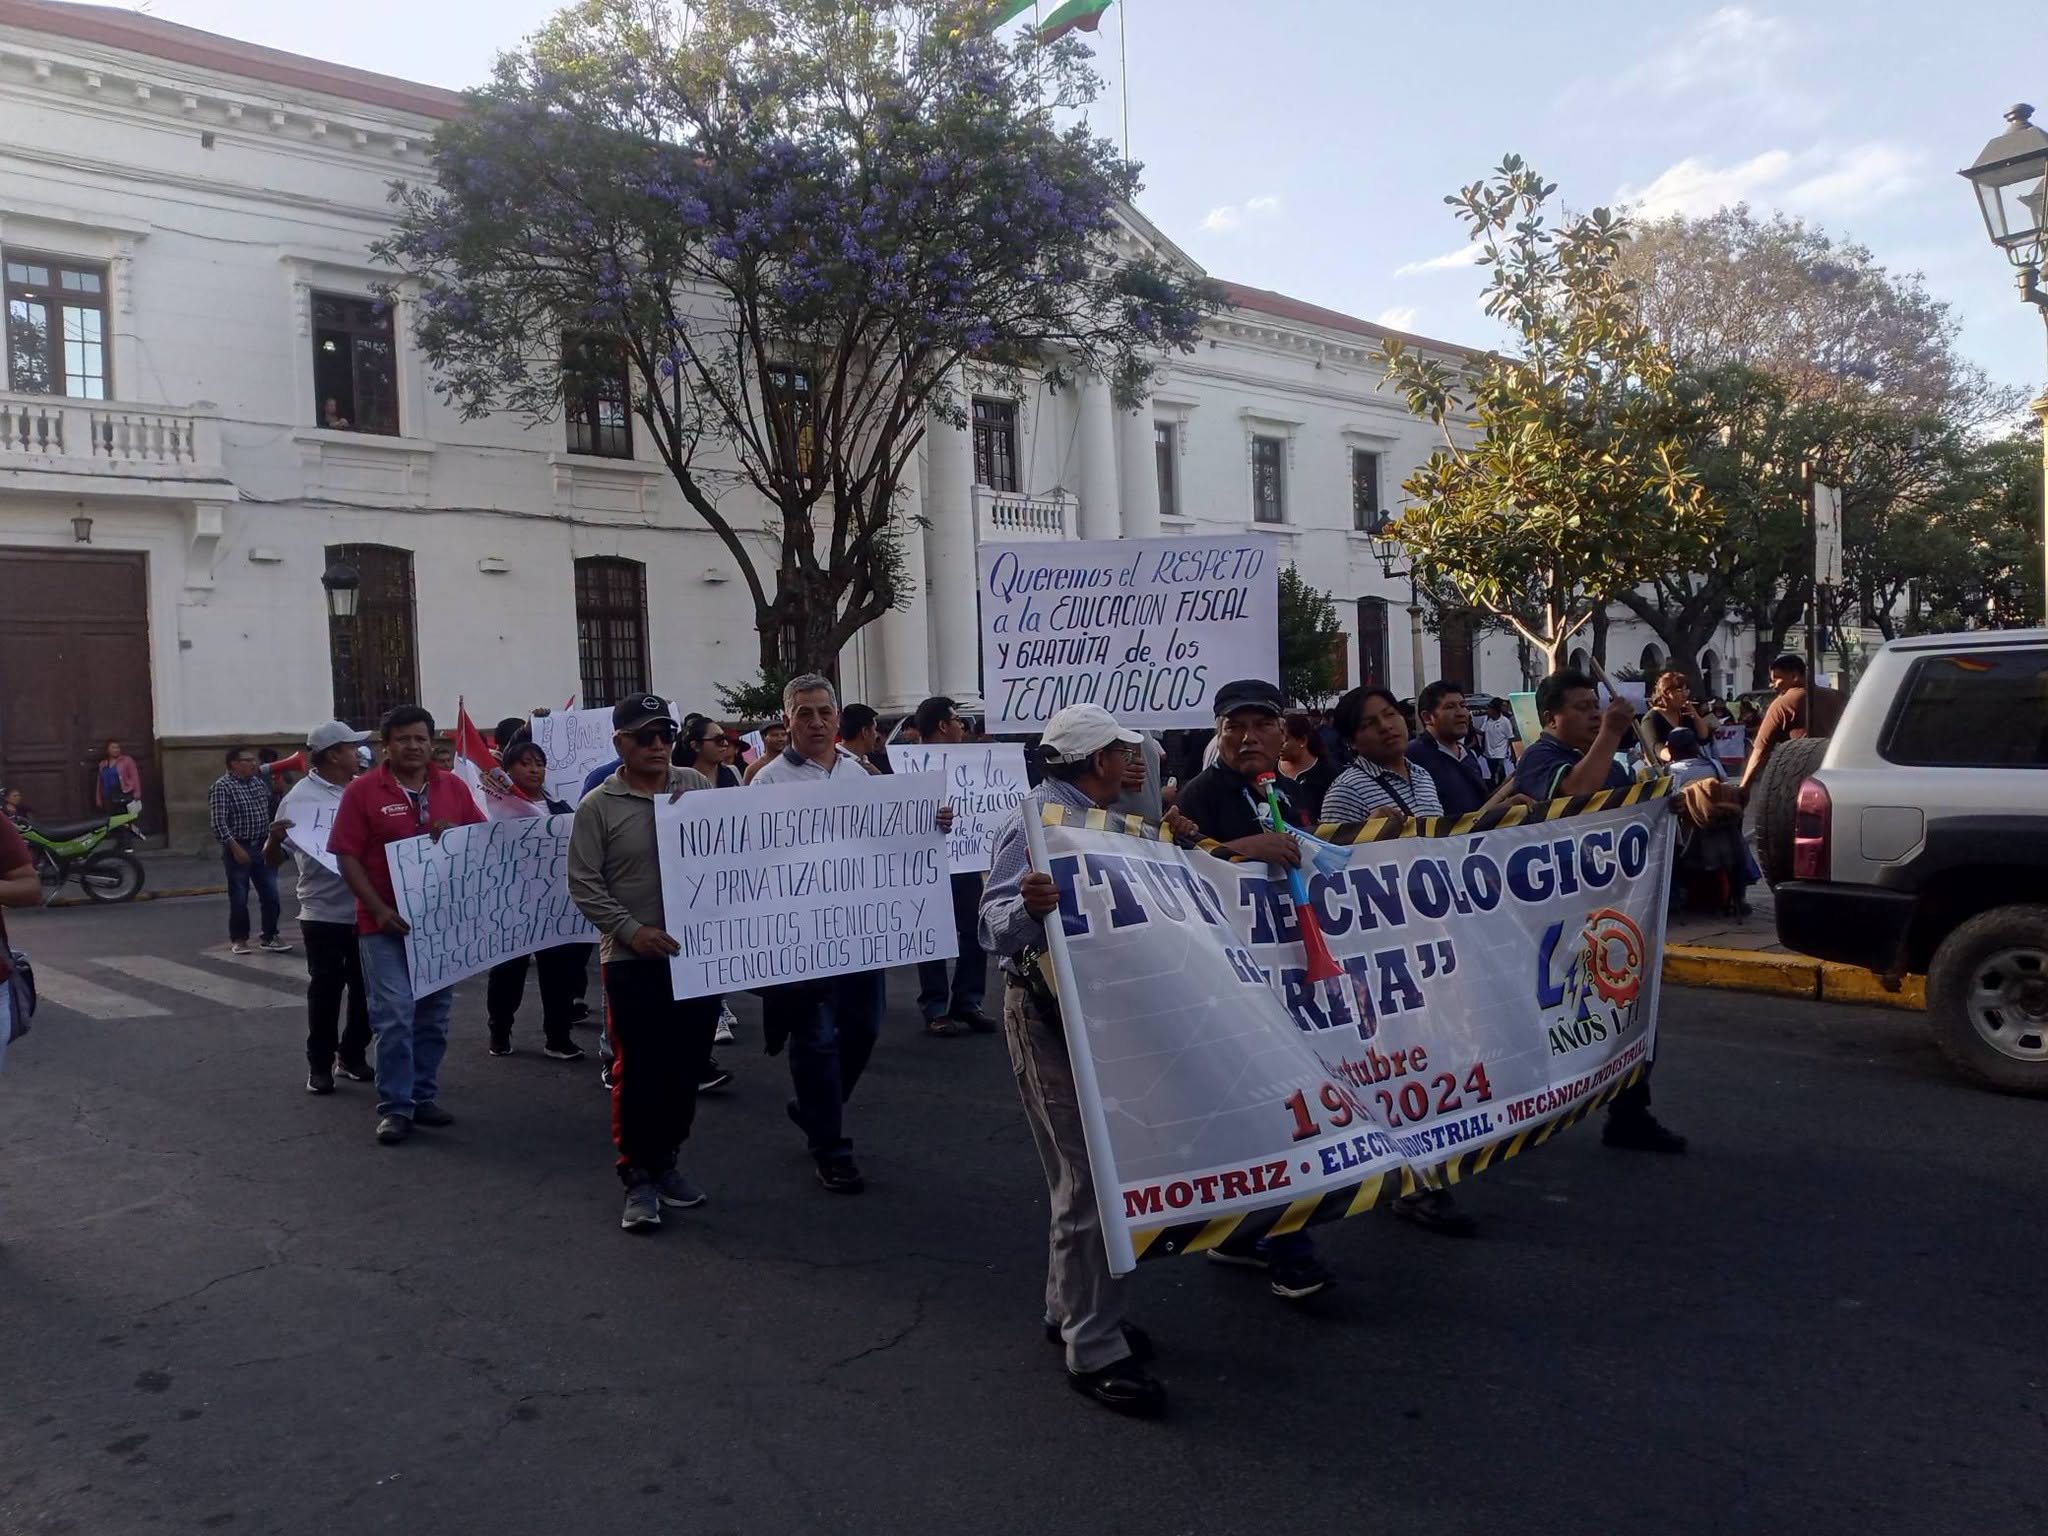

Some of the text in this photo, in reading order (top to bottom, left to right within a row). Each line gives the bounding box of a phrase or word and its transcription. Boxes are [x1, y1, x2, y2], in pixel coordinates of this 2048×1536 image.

[989, 548, 1263, 603] Queremos el RESPETO
[993, 587, 1249, 634] a la EDUCACION FISCAL
[1125, 629, 1151, 662] de
[1166, 627, 1200, 662] los
[759, 799, 940, 850] DESCENTRALIZACION
[443, 836, 568, 879] TRANSFE
[686, 848, 938, 909] Y PRIVATIZACION DE LOS
[1239, 824, 1649, 945] TECNOLÓGICO
[684, 912, 801, 958] INSTITUTOS
[914, 897, 925, 928] Y
[699, 928, 936, 988] TECNOLÓGICOS DEL PAIS
[1549, 1014, 1607, 1057] AÑOS
[1375, 1062, 1493, 1128] 2024
[1122, 1160, 1292, 1218] MOTRIZ
